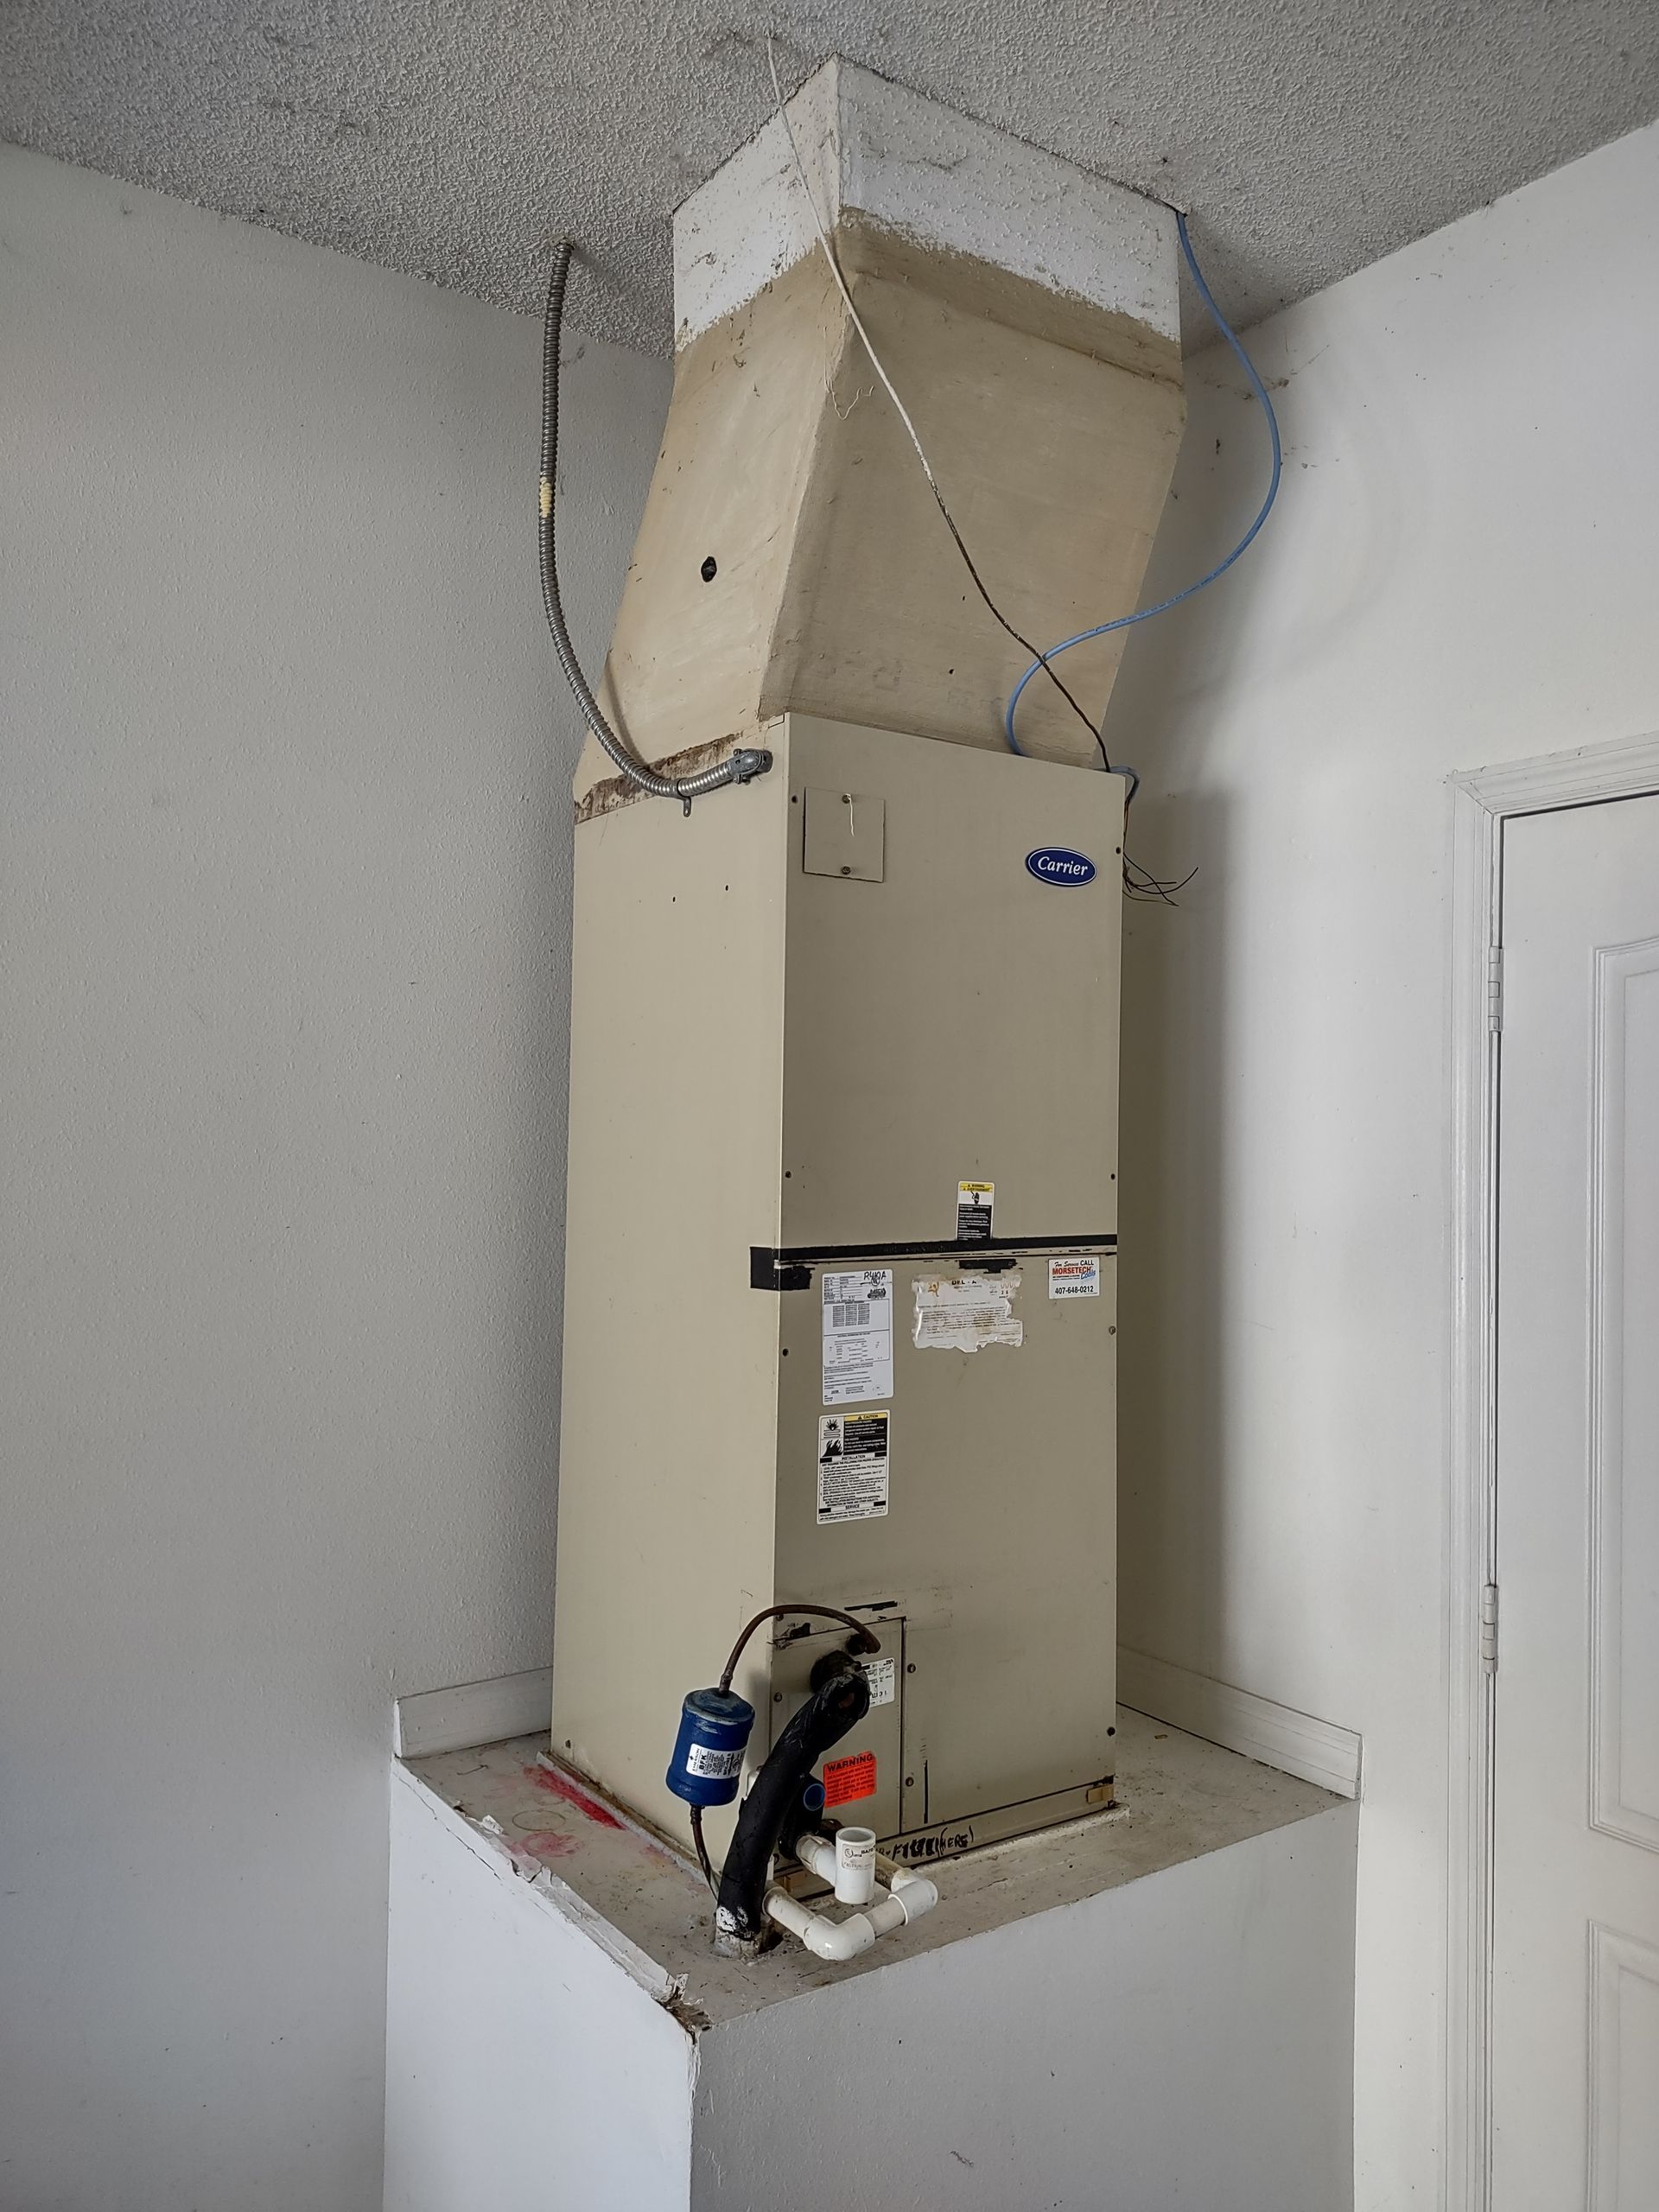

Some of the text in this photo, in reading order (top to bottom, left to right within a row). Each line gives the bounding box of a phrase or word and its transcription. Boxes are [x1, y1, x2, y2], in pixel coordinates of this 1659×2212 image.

[1038, 856, 1088, 875] Carrier
[1052, 1267, 1091, 1275] MORSETECH
[1055, 1286, 1094, 1294] 407-648-0212
[828, 1753, 873, 1772] WARNING
